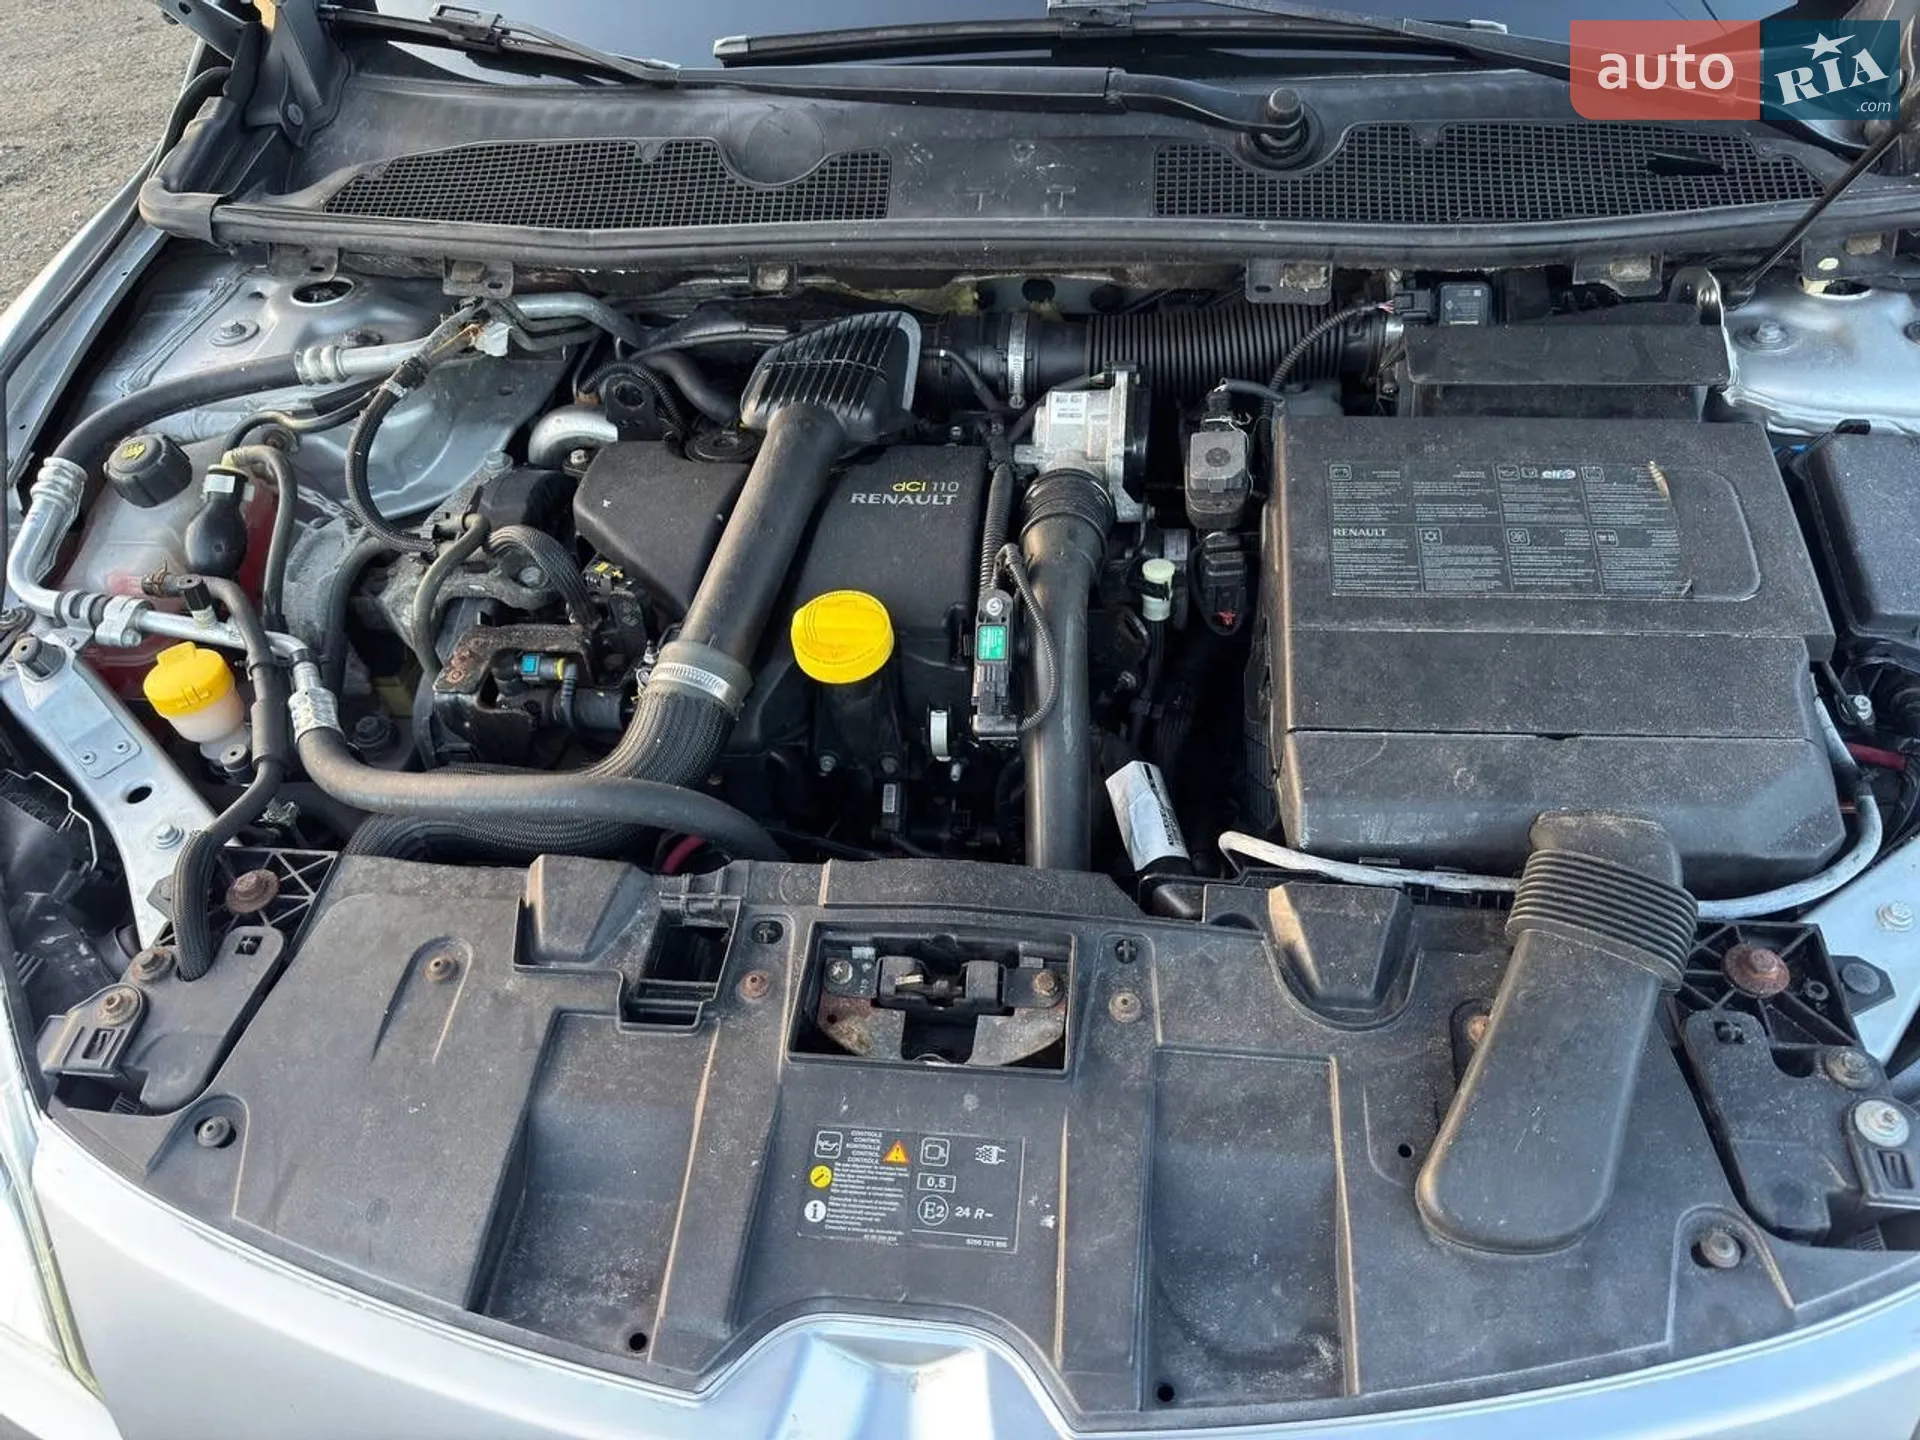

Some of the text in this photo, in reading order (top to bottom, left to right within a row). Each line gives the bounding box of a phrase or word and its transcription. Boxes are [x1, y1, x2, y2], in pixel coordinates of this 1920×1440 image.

[931, 481, 960, 492] 110
[850, 493, 958, 506] RENAULT
[1332, 528, 1388, 538] RENAULT
[926, 1176, 947, 1189] 0,5
[923, 1201, 945, 1220] E2
[954, 1206, 971, 1218] 24
